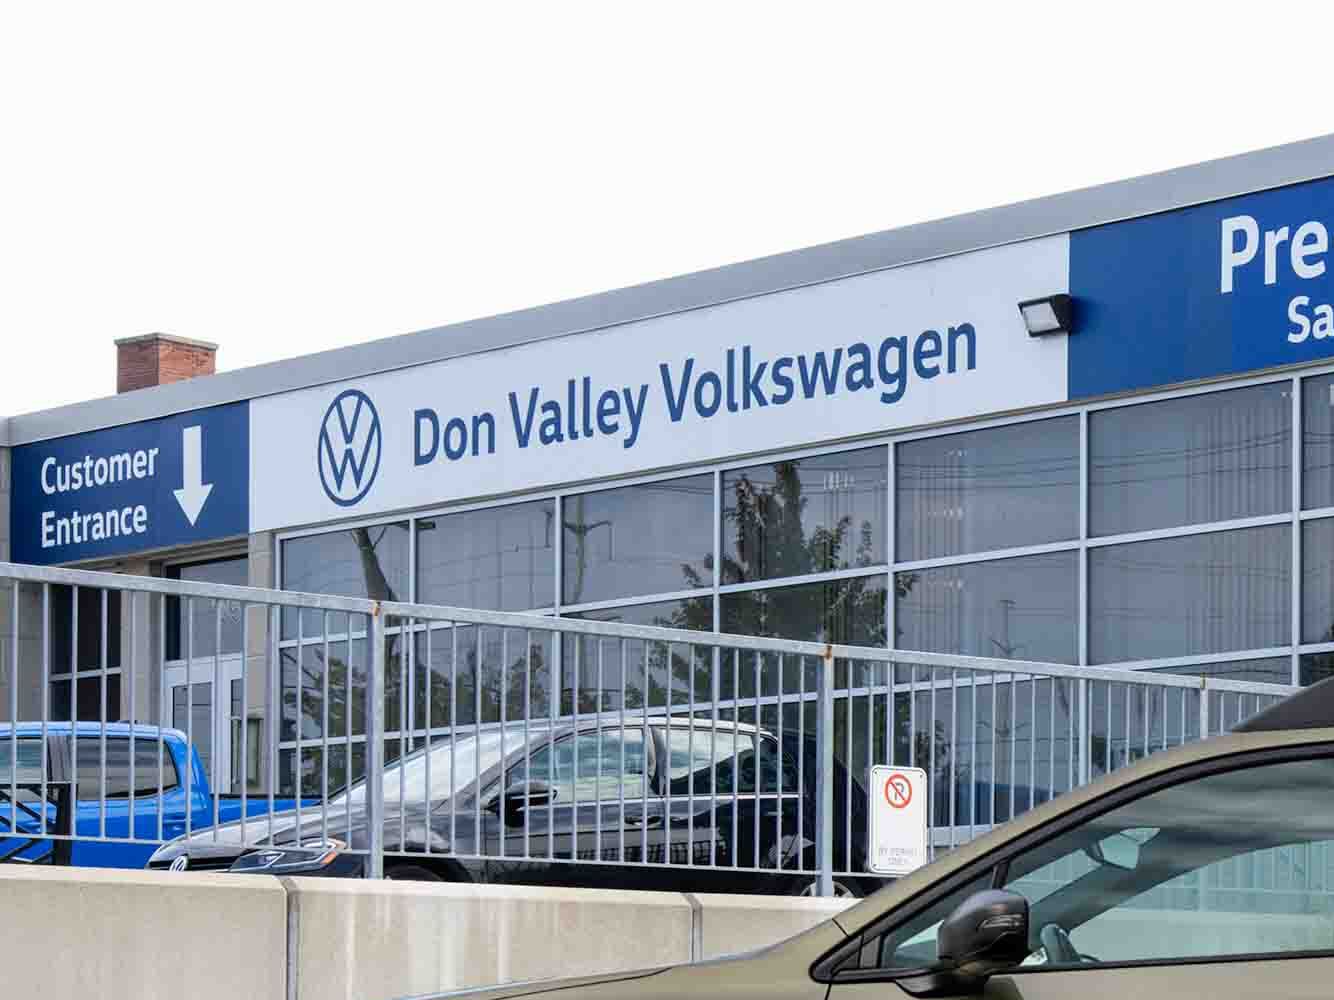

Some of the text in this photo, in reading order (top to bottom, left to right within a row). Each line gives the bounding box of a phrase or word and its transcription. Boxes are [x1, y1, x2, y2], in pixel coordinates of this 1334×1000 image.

[413, 321, 978, 466] Don Valley Volkswagen
[40, 445, 160, 495] Customer
[40, 504, 148, 548] Entrance
